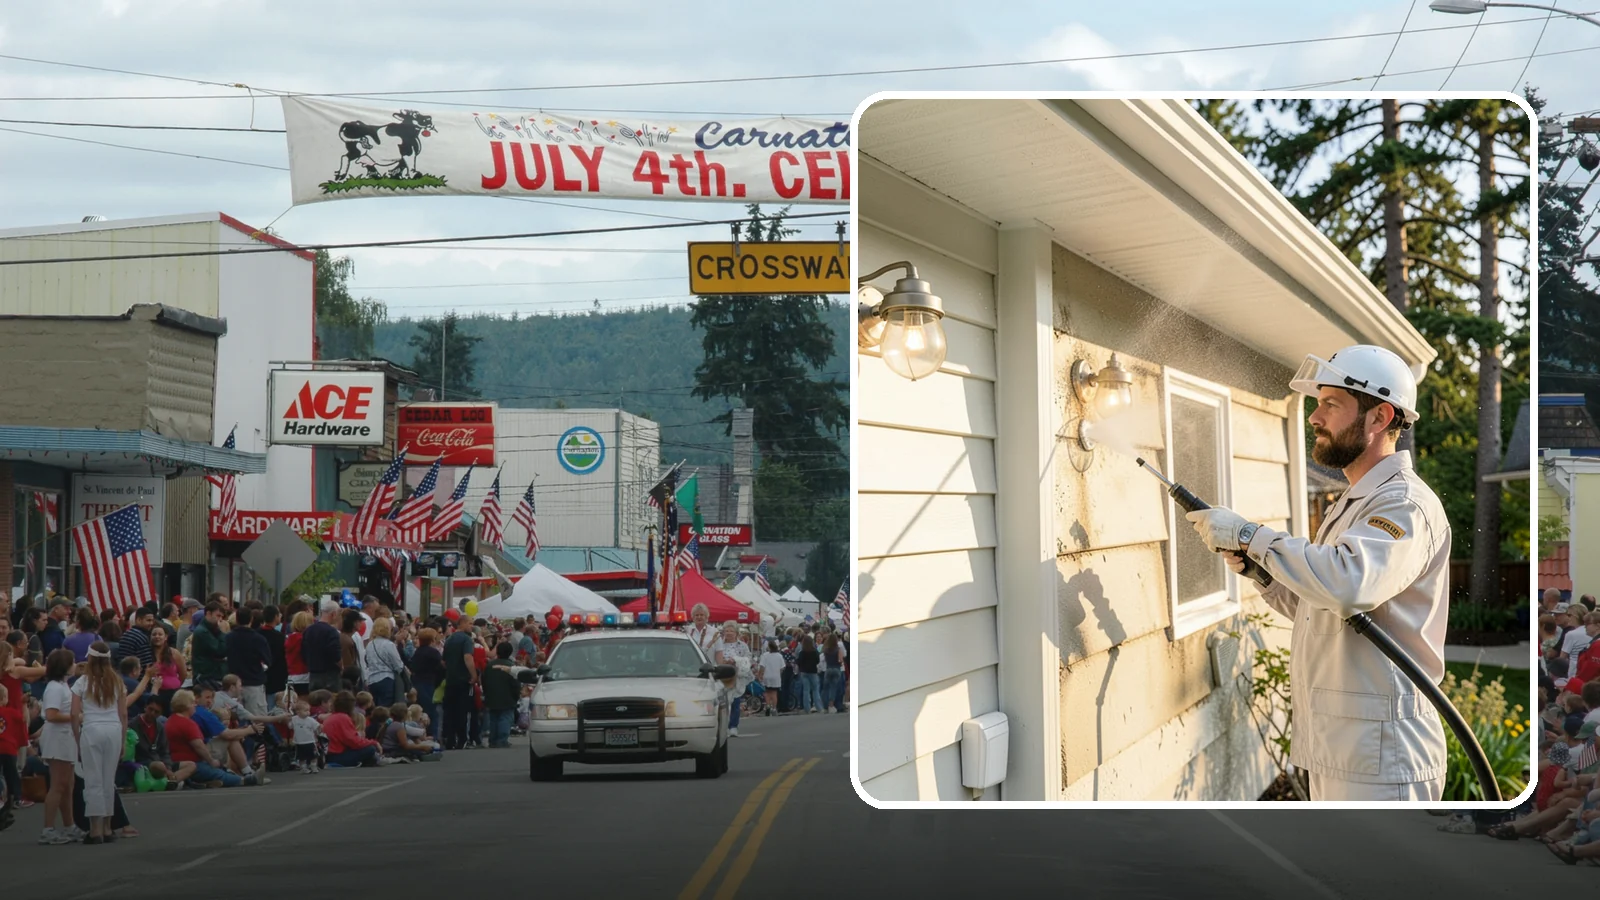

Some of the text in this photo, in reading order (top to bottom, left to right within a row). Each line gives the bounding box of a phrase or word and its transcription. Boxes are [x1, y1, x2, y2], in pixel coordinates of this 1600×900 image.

[481, 141, 605, 192] JULY
[632, 150, 746, 198] 4th.
[697, 254, 850, 280] CROSSWA
[283, 380, 373, 420] ACE
[405, 409, 452, 422] CEDAR
[283, 421, 371, 436] Hardware
[95, 485, 124, 495] Vincent
[126, 486, 136, 495] de
[137, 486, 155, 495] Paul
[688, 526, 741, 535] CRNATION
[699, 535, 730, 543] GLASS
